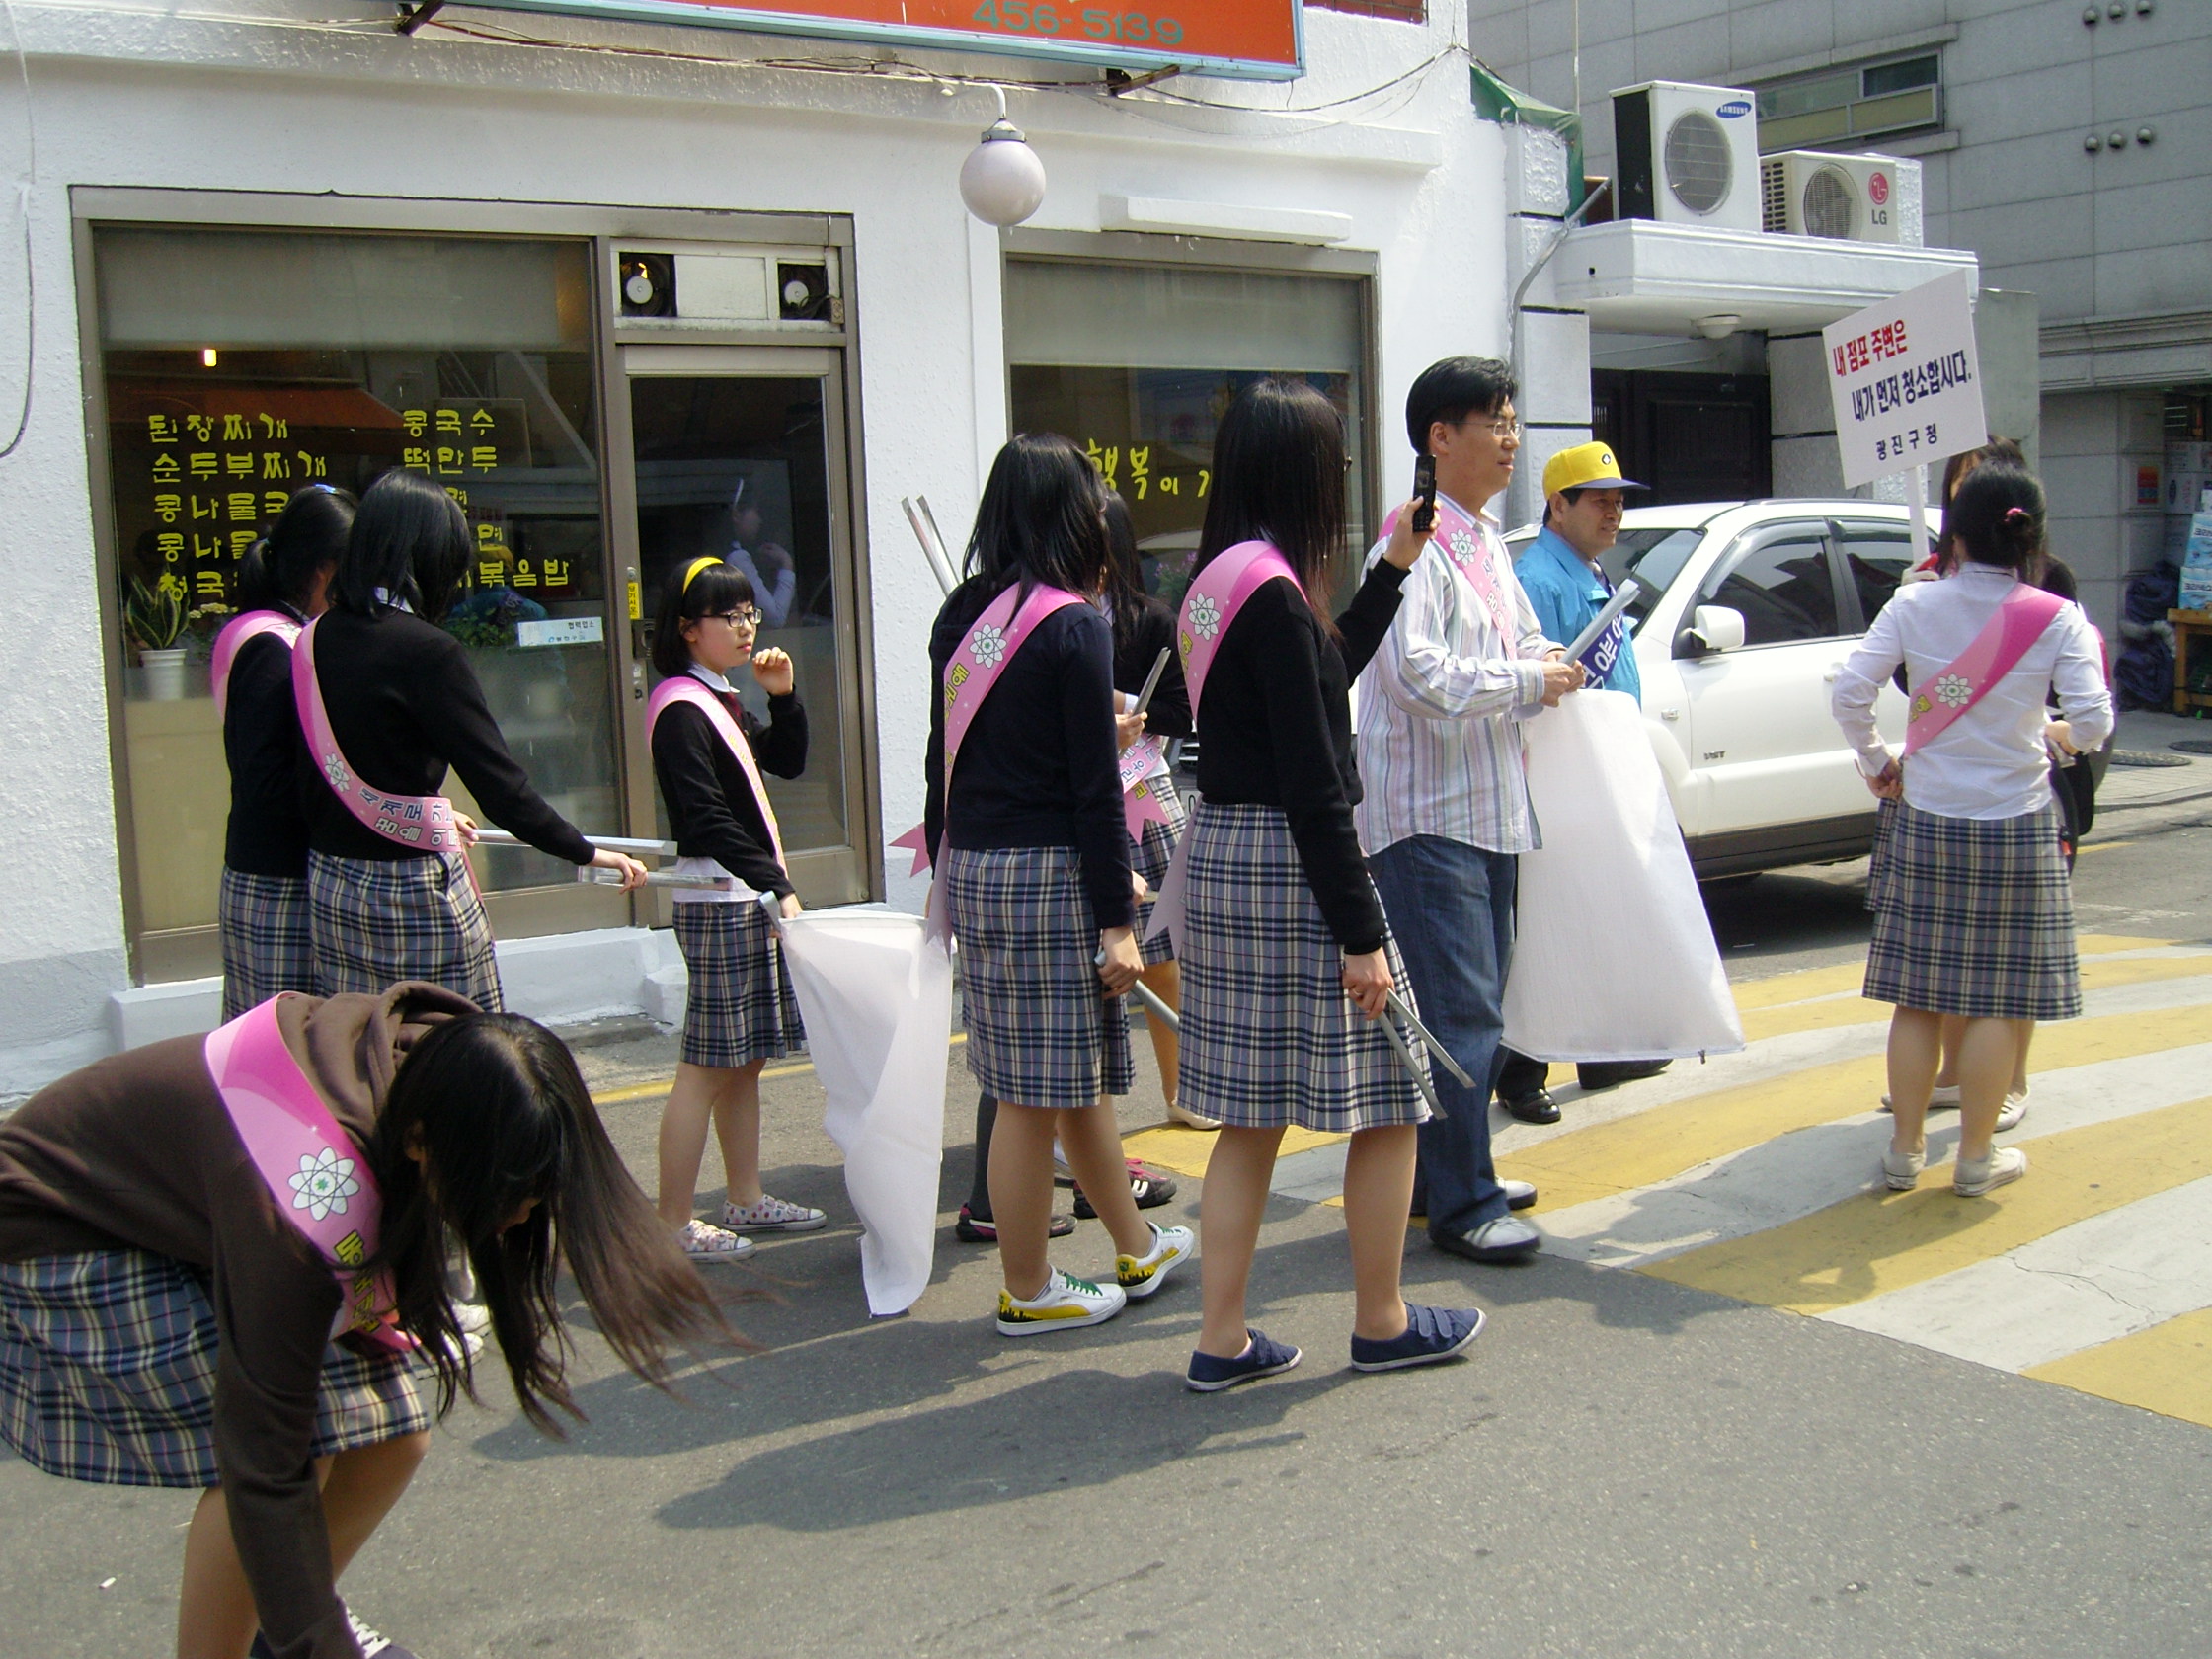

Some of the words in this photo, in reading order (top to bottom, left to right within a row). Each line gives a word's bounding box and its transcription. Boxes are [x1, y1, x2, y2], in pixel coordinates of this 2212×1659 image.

[972, 0, 1183, 44] 456-5139
[1718, 105, 1749, 116] SAMSUNG
[1871, 210, 1888, 226] LG
[1833, 345, 1847, 377] 내
[1846, 335, 1870, 372] 점포
[1871, 319, 1908, 362] 주변은
[1852, 385, 1875, 421] 내가
[1876, 375, 1901, 413] 먼저
[149, 412, 288, 442] 된장찌개
[403, 408, 495, 437] 콩국수
[1876, 423, 1938, 461] 광진구청
[152, 450, 327, 483] 순두부찌개
[404, 446, 497, 475] 떡만두
[159, 571, 238, 601] 청국
[457, 558, 570, 589] 볶음밥
